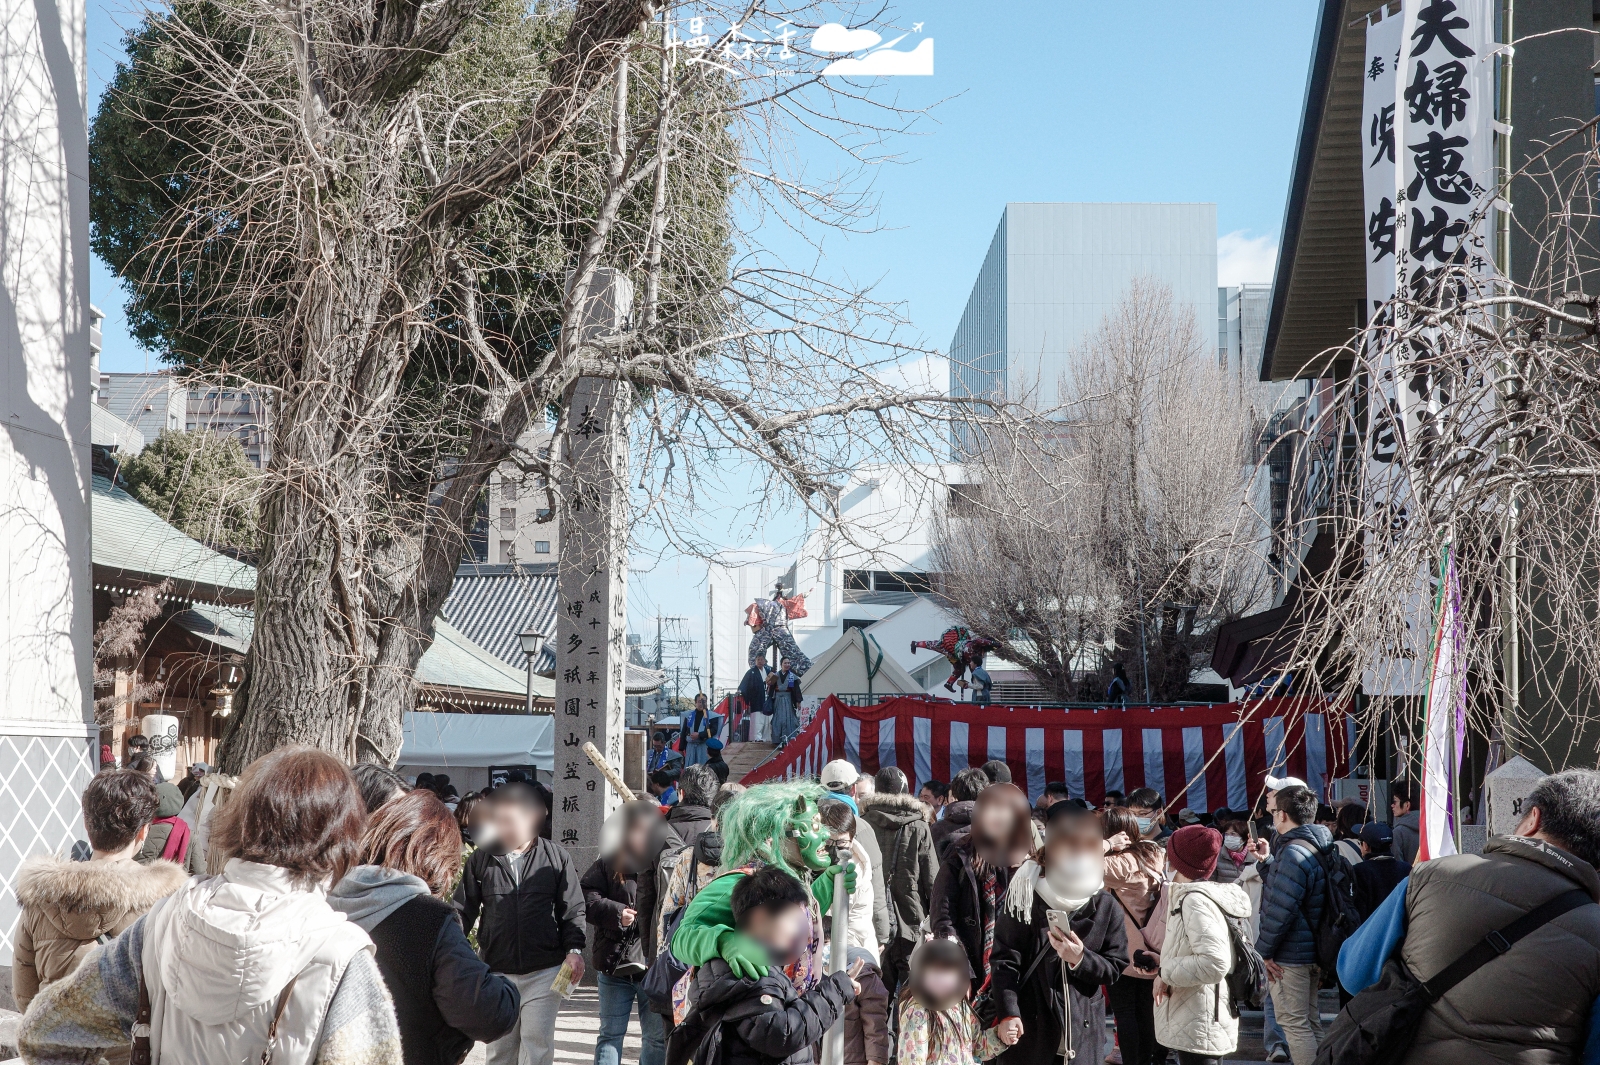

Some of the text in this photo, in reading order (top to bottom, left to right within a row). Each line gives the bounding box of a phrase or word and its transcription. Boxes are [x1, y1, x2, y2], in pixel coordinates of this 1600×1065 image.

[560, 600, 585, 873] 博多祇園山笠振興
[1545, 848, 1574, 868] SPIRIT
